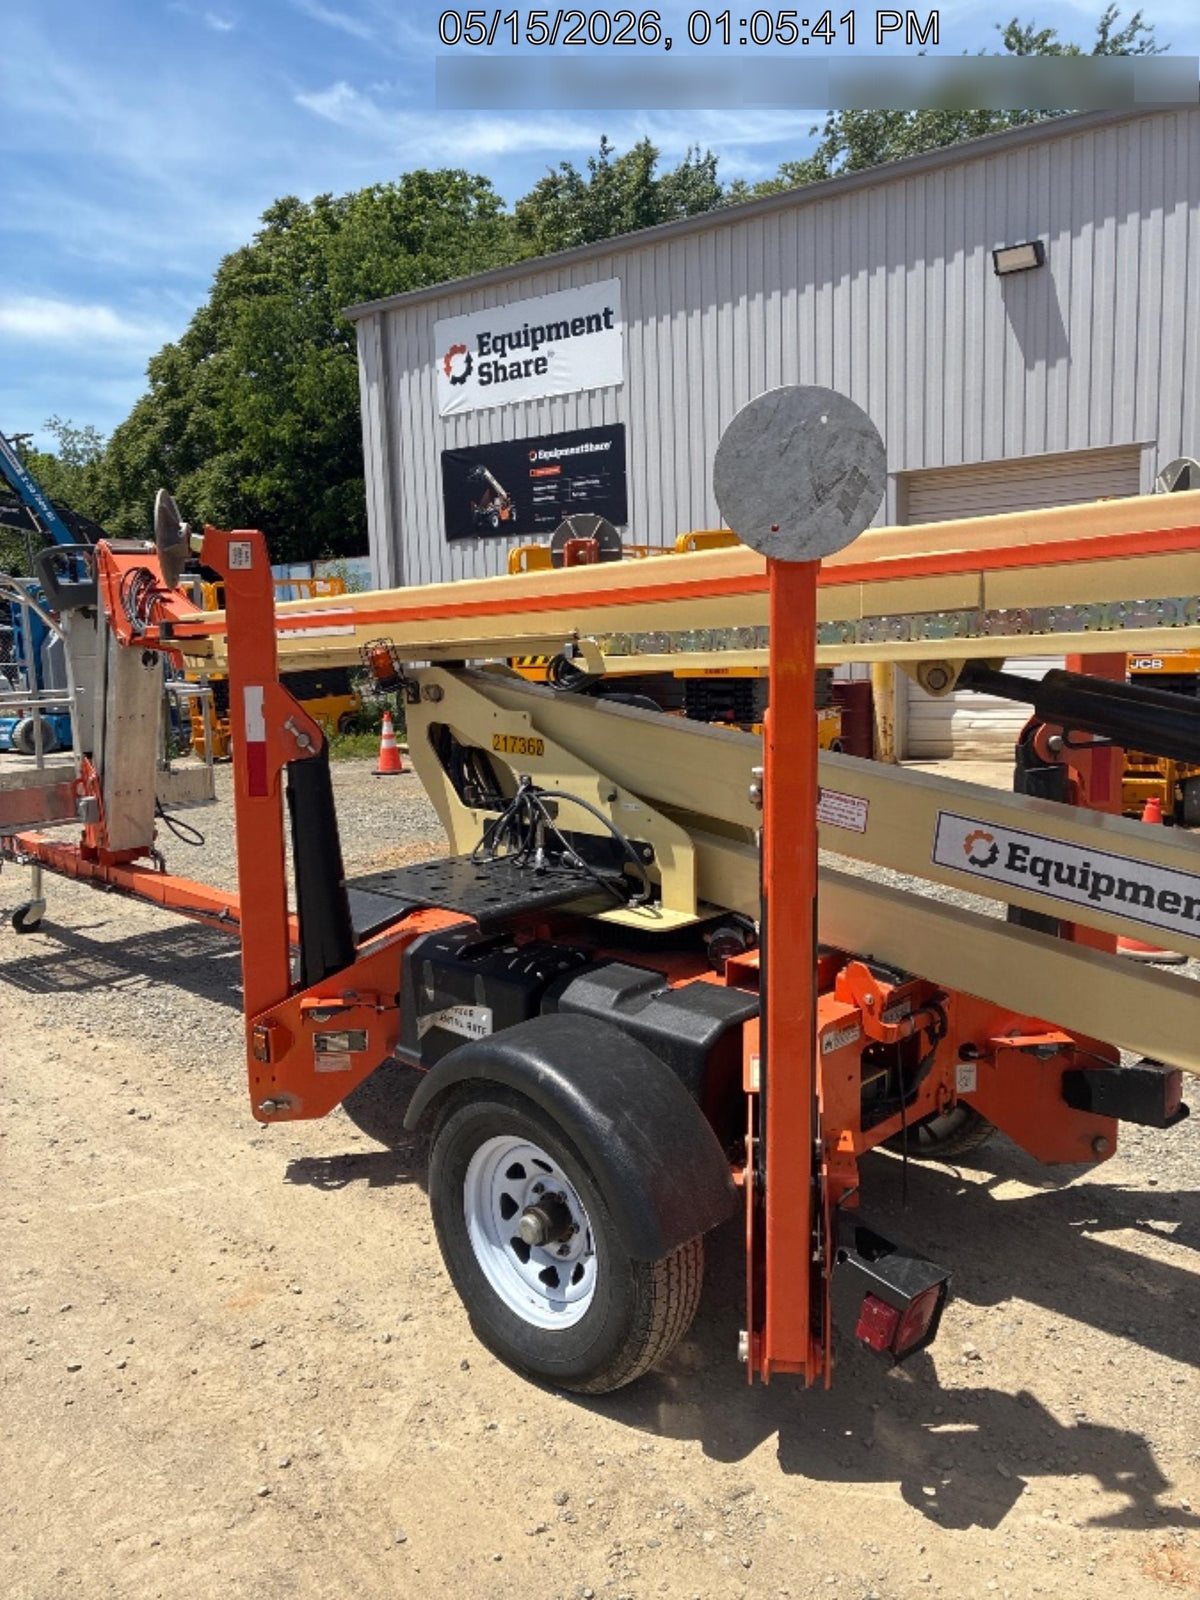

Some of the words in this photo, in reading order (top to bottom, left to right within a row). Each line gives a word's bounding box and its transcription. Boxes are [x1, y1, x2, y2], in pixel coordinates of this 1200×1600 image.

[476, 306, 614, 358] Equipment
[478, 355, 548, 386] Share
[1129, 659, 1164, 669] JCB
[493, 734, 545, 757] 217360
